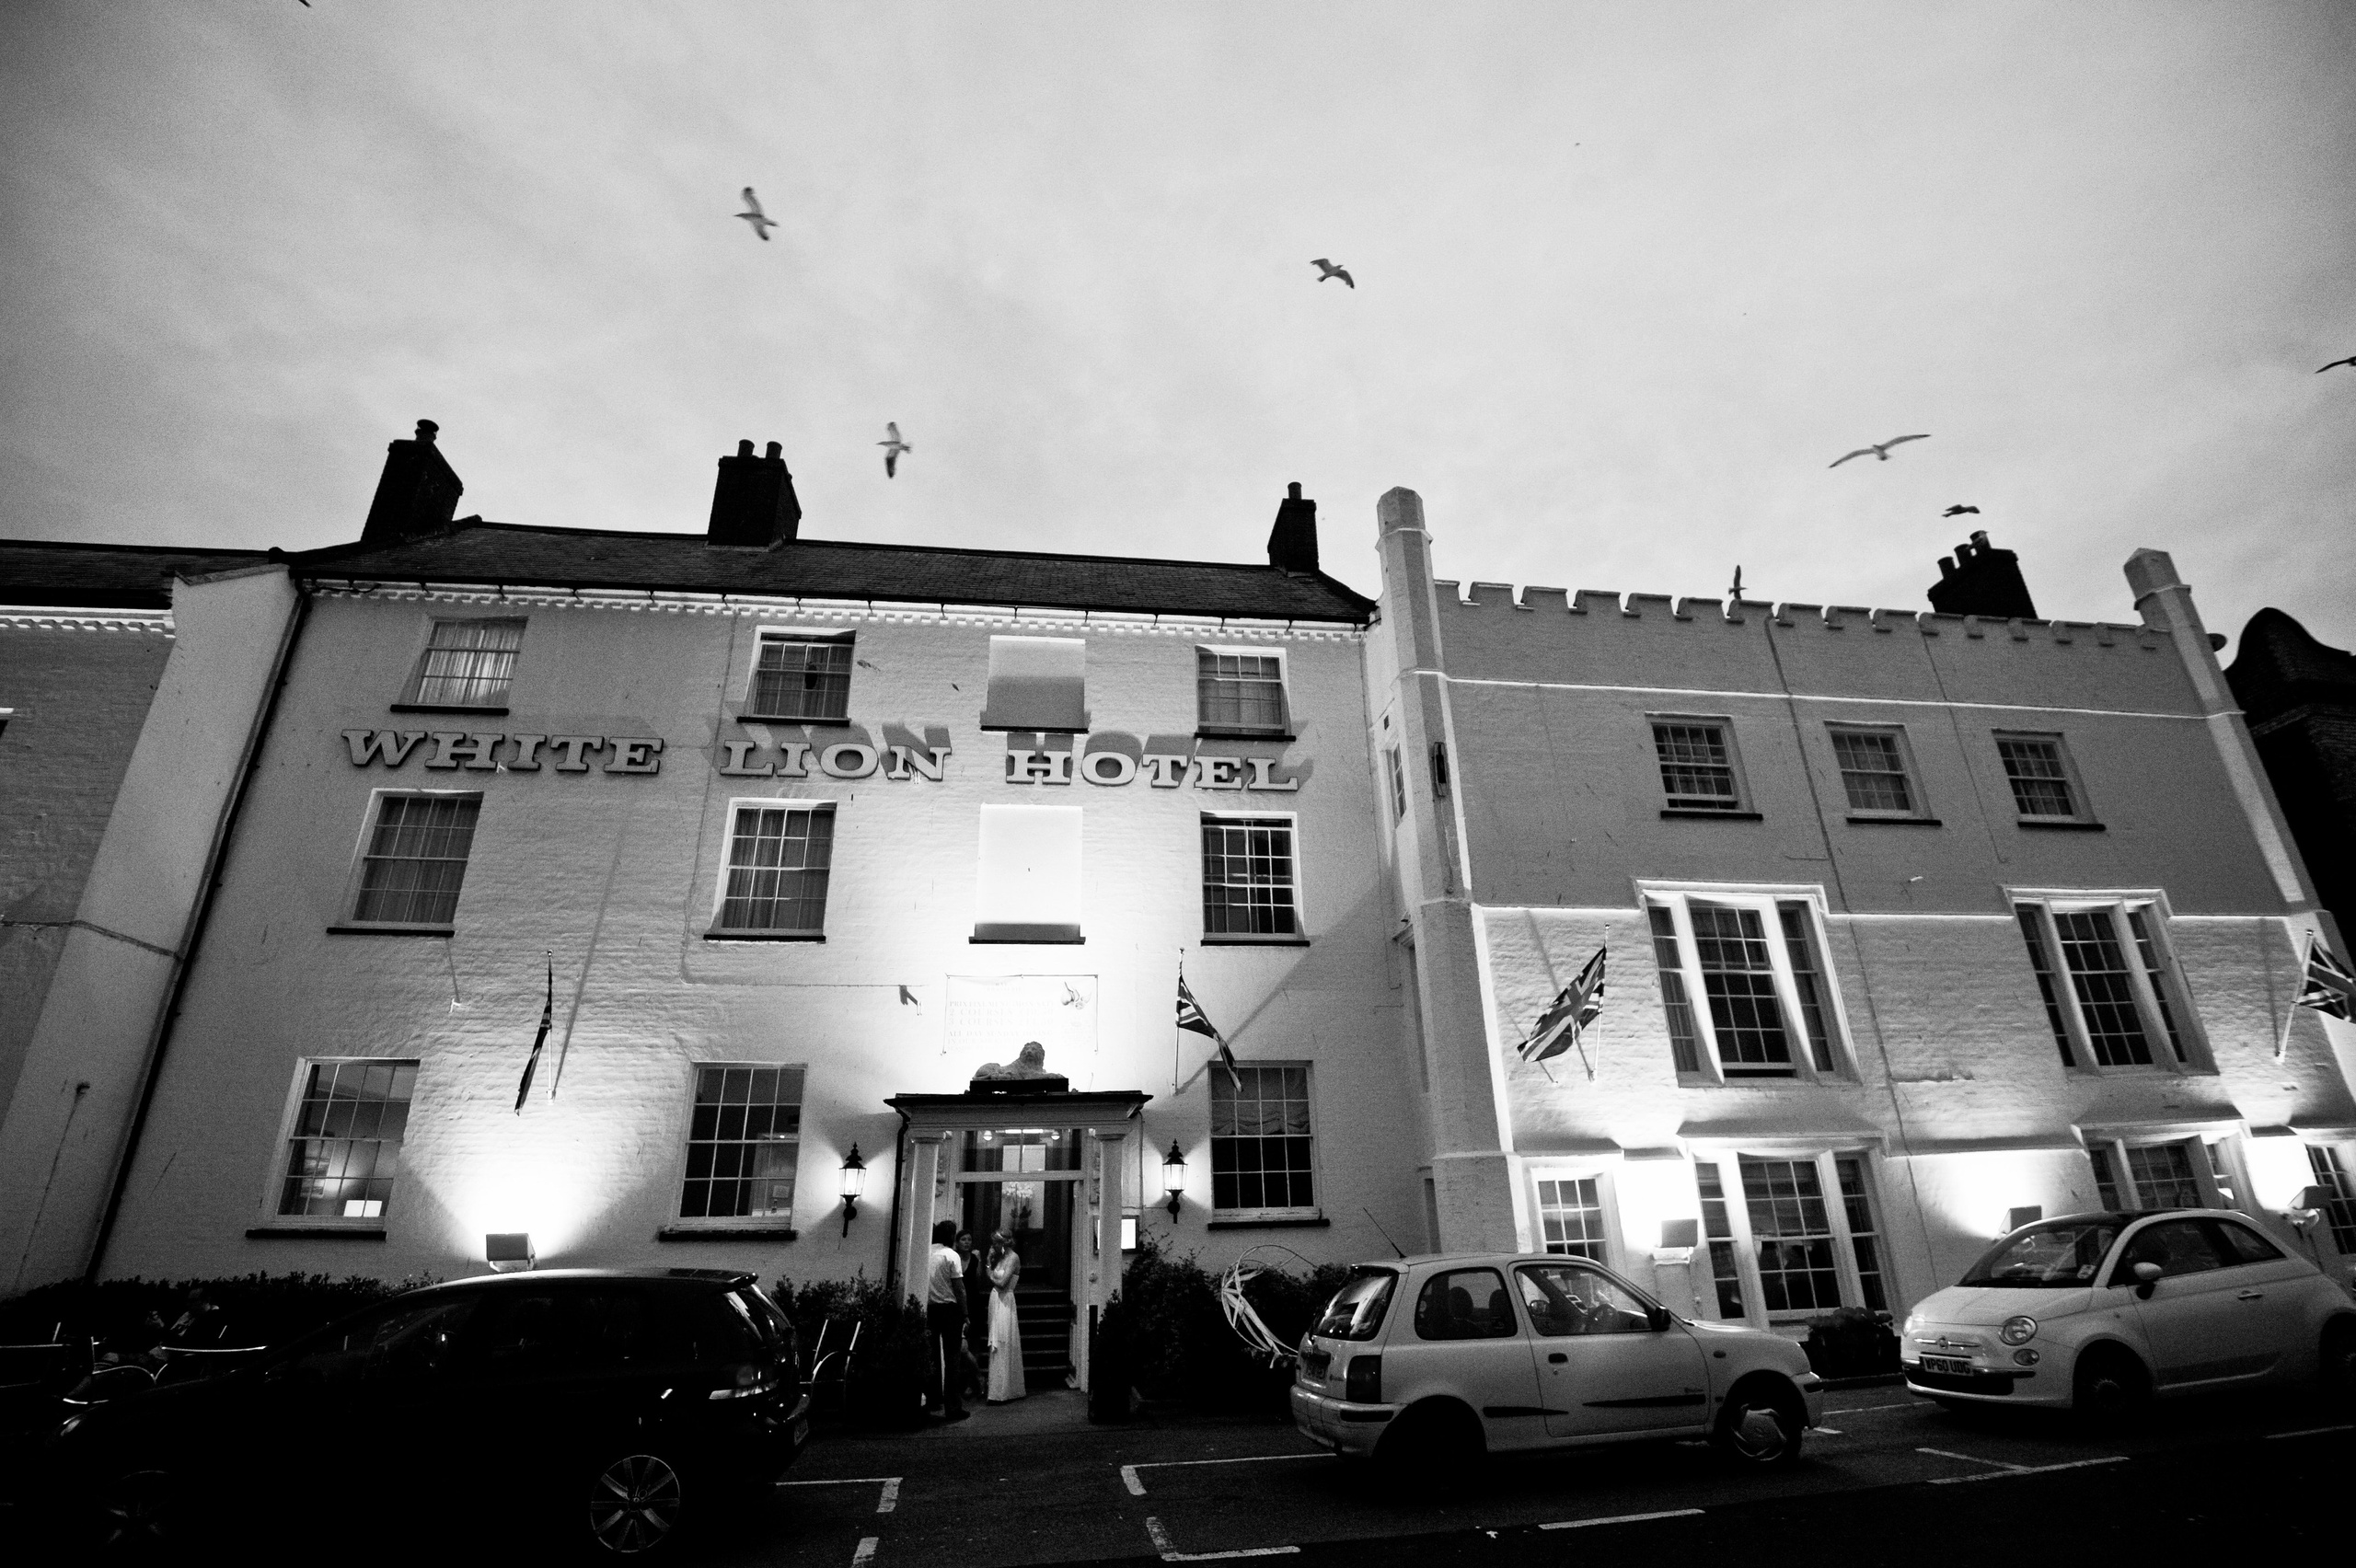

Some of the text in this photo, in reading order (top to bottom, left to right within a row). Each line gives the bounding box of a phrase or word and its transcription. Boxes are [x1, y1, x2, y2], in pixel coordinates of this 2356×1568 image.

[340, 729, 1299, 791] WHITE LION HOTEL
